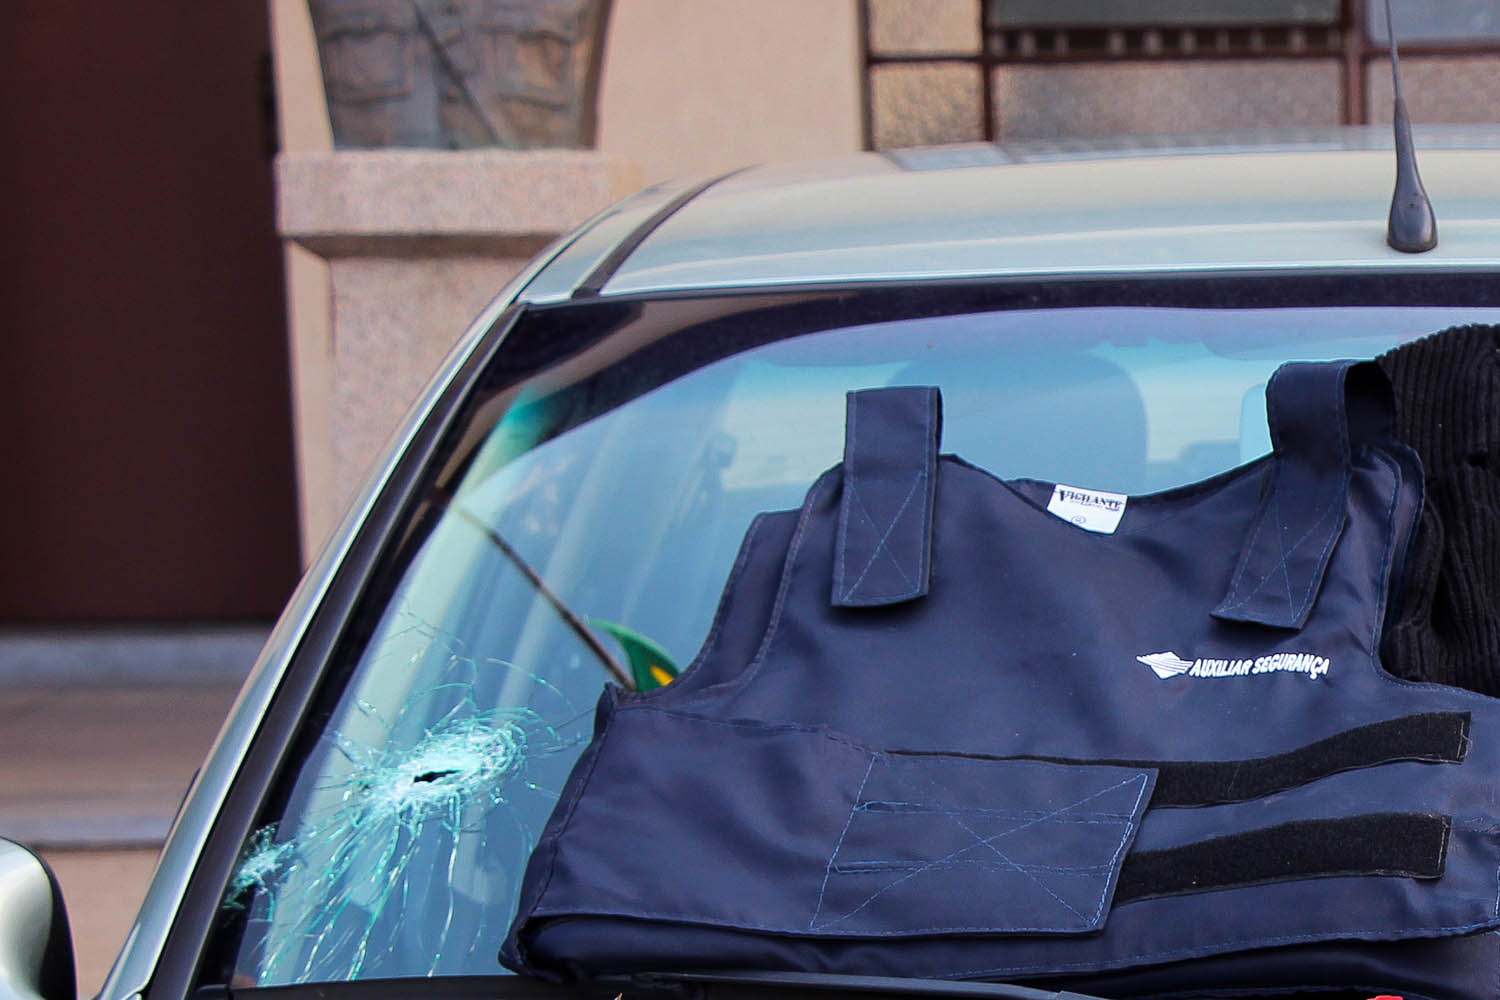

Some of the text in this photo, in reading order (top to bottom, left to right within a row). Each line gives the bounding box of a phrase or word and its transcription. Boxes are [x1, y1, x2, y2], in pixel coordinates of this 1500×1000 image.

[1059, 490, 1122, 508] VIGILANTE
[1188, 653, 1331, 680] AUXILIAR SEGURANÇA
